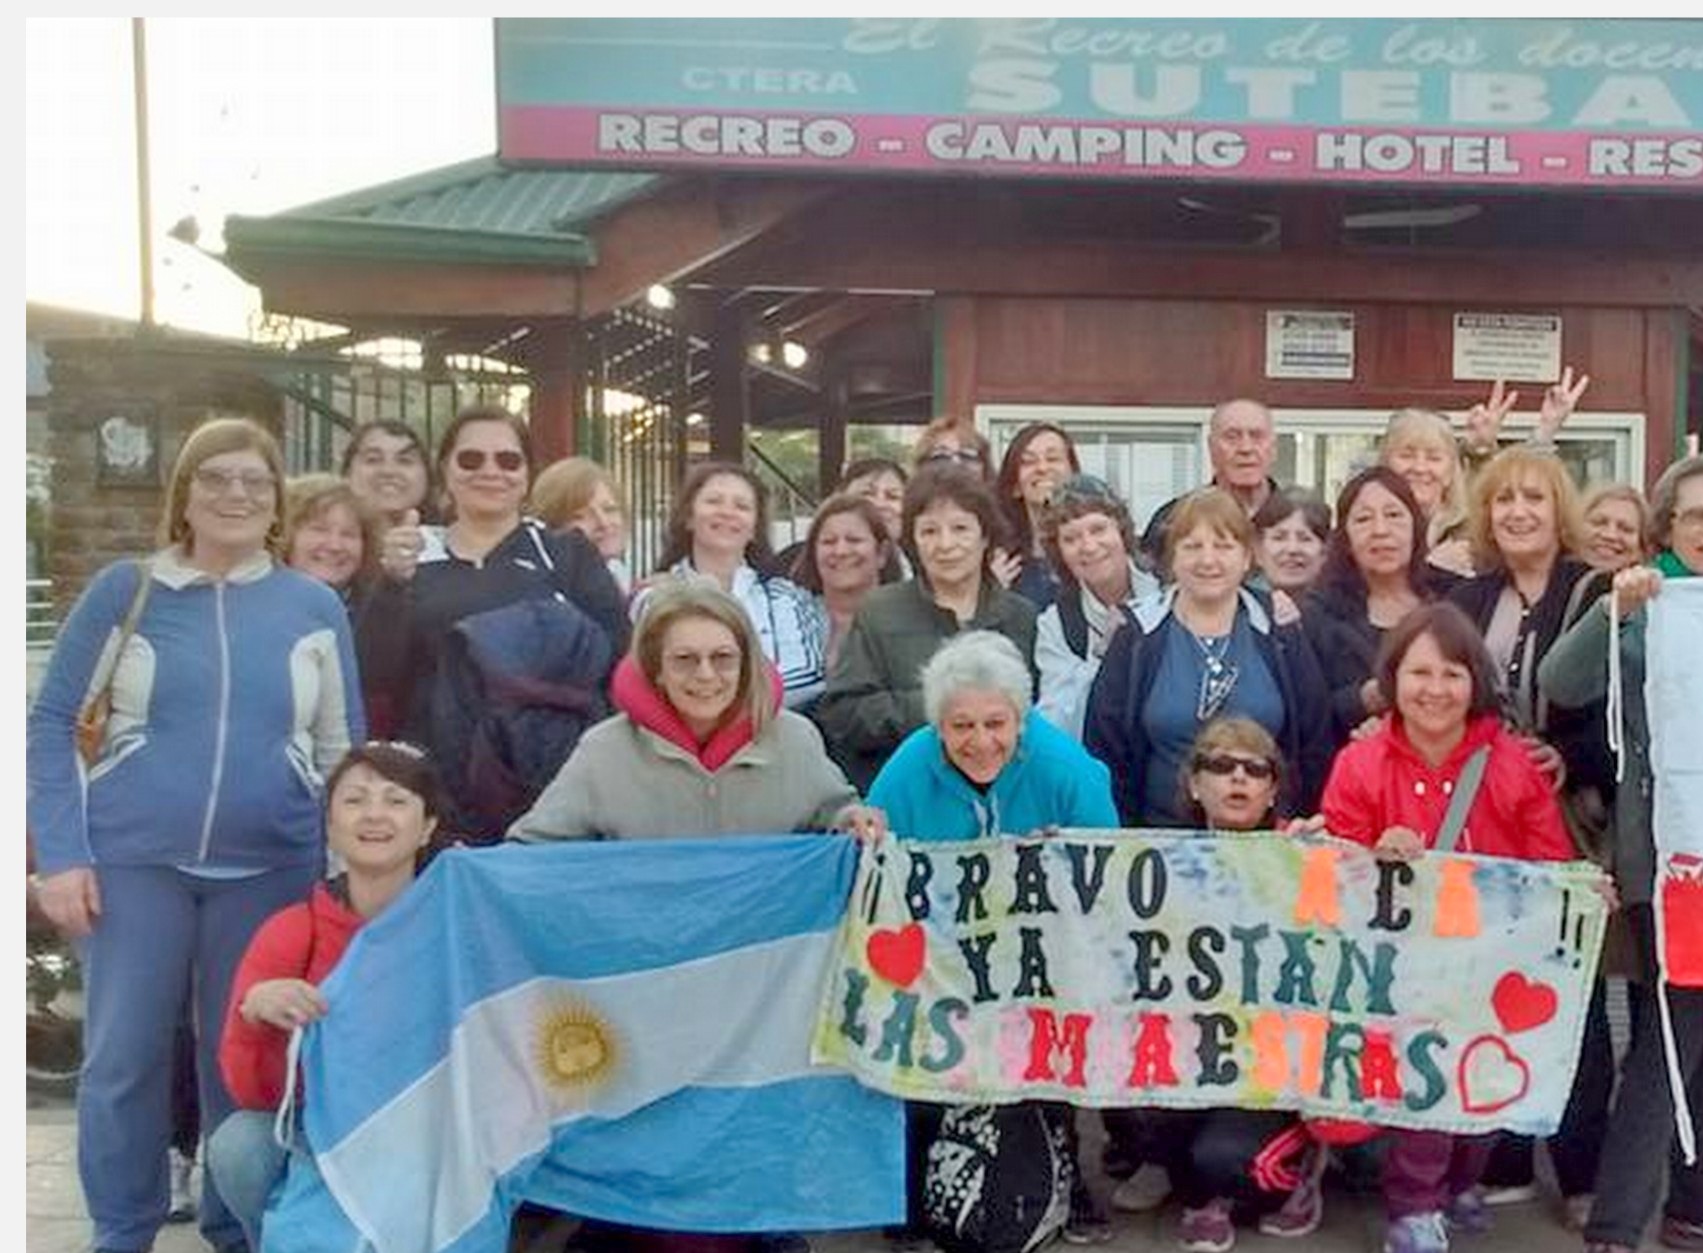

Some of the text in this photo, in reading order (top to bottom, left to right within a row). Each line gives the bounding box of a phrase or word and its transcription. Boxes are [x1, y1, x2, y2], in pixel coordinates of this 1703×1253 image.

[1264, 23, 1353, 63] de
[1382, 27, 1484, 66] los
[681, 67, 859, 95] CTERA
[966, 59, 1694, 128] SUTEBA
[598, 114, 857, 158] RECREO
[925, 122, 1247, 169] CAMPING
[1315, 132, 1521, 174] HOTEL
[956, 927, 1057, 1004] YA
[839, 967, 1450, 1113] LAS MAESTRAS
